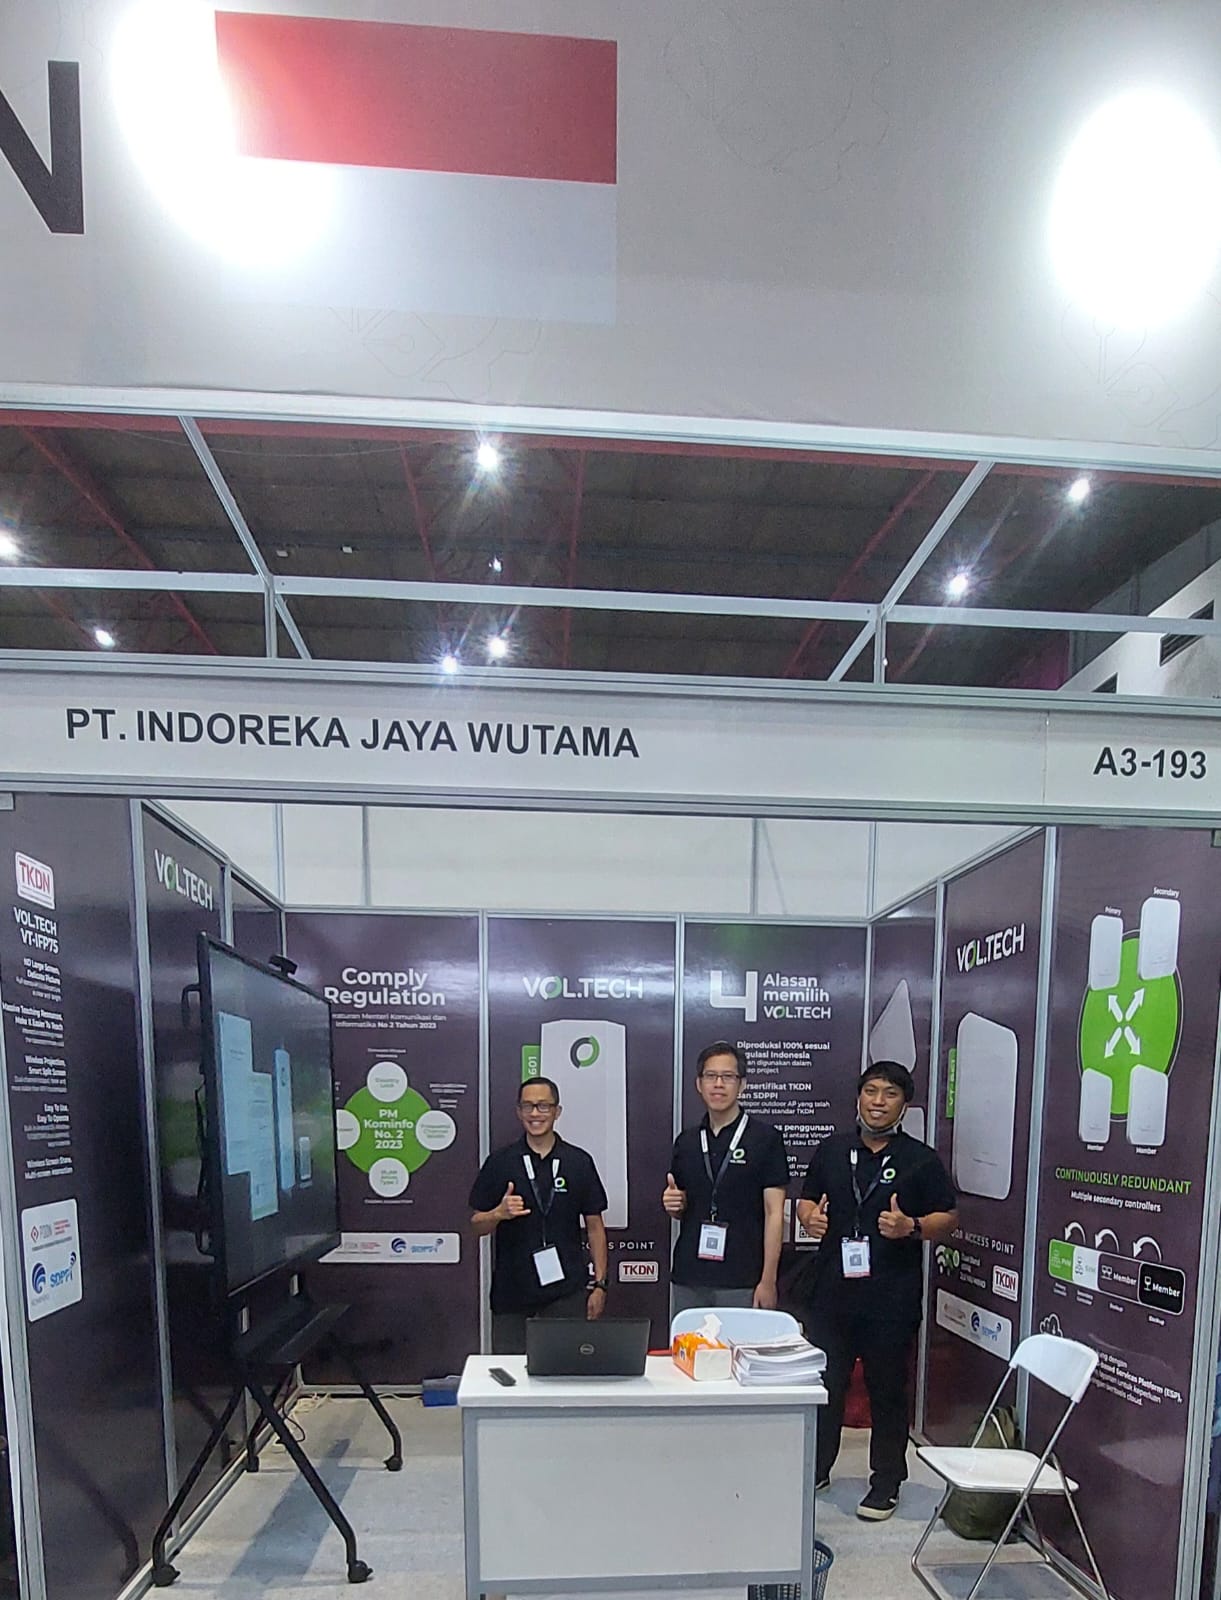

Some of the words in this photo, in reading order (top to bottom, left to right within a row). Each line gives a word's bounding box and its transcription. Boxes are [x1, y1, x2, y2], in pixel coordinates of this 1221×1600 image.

[66, 708, 126, 740] PT.
[136, 710, 349, 748] INDOREKA
[361, 718, 457, 751] JAYA
[467, 722, 639, 758] WUTAMA
[1093, 746, 1206, 779] A3-193
[18, 860, 51, 894] TKDN
[1153, 887, 1180, 898] Secondary
[957, 922, 1025, 972] VOL.TECH
[341, 967, 428, 992] Comply
[763, 973, 818, 988] Alasan
[522, 976, 643, 1000] VOL.TECH
[763, 988, 830, 1002] memilih
[323, 987, 446, 1009] Regulation
[710, 970, 758, 1022] 4
[763, 1005, 832, 1019] VOL.TECH
[395, 1021, 418, 1029] Tahun
[737, 1040, 781, 1051] Diproduksi
[782, 1041, 803, 1050] 100%
[804, 1042, 830, 1050] sesuai
[770, 1051, 810, 1059] Indonesia
[757, 1060, 790, 1068] digunakan
[379, 1109, 398, 1118] PM
[364, 1118, 414, 1129] Kominfo
[784, 1124, 835, 1133] penggunaan
[374, 1130, 394, 1139] No.
[396, 1130, 404, 1139] 2
[375, 1139, 403, 1149] 2023
[1055, 1167, 1120, 1186] CONTINUOUSLY
[1121, 1175, 1192, 1195] REDUNDANT
[1070, 1191, 1093, 1202] Multiple
[1093, 1195, 1124, 1208] secondary
[1125, 1200, 1161, 1213] controllers
[620, 1241, 655, 1250] POINT
[964, 1231, 989, 1248] ACCESS
[991, 1240, 1015, 1255] POINT
[623, 1264, 655, 1275] TKDN
[995, 1270, 1017, 1291] TKDN
[1112, 1272, 1137, 1286] Member
[1152, 1282, 1181, 1298] Member
[1138, 1376, 1164, 1394] Platform
